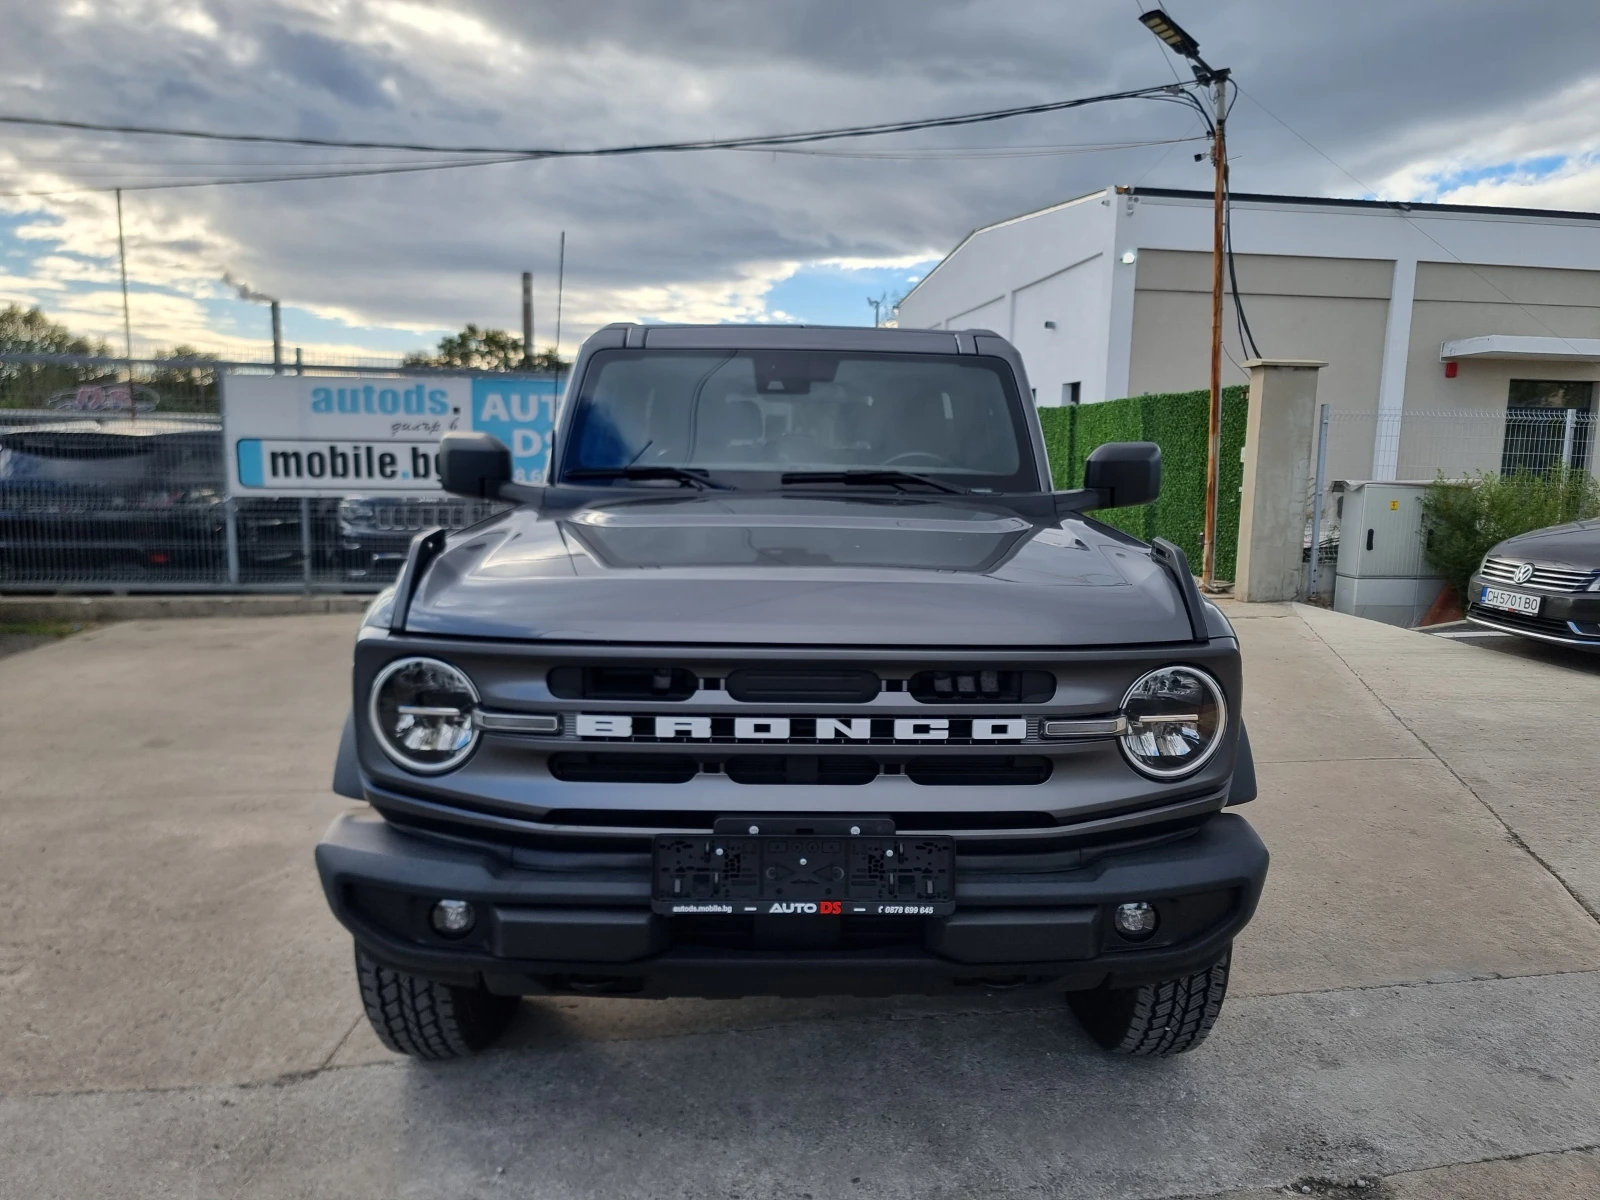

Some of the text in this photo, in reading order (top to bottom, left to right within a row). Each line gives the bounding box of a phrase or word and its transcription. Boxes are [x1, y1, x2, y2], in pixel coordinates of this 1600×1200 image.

[481, 393, 563, 423] AUT
[576, 715, 1027, 739] BRONCO
[769, 902, 818, 914] AUTO
[820, 901, 842, 915] DS
